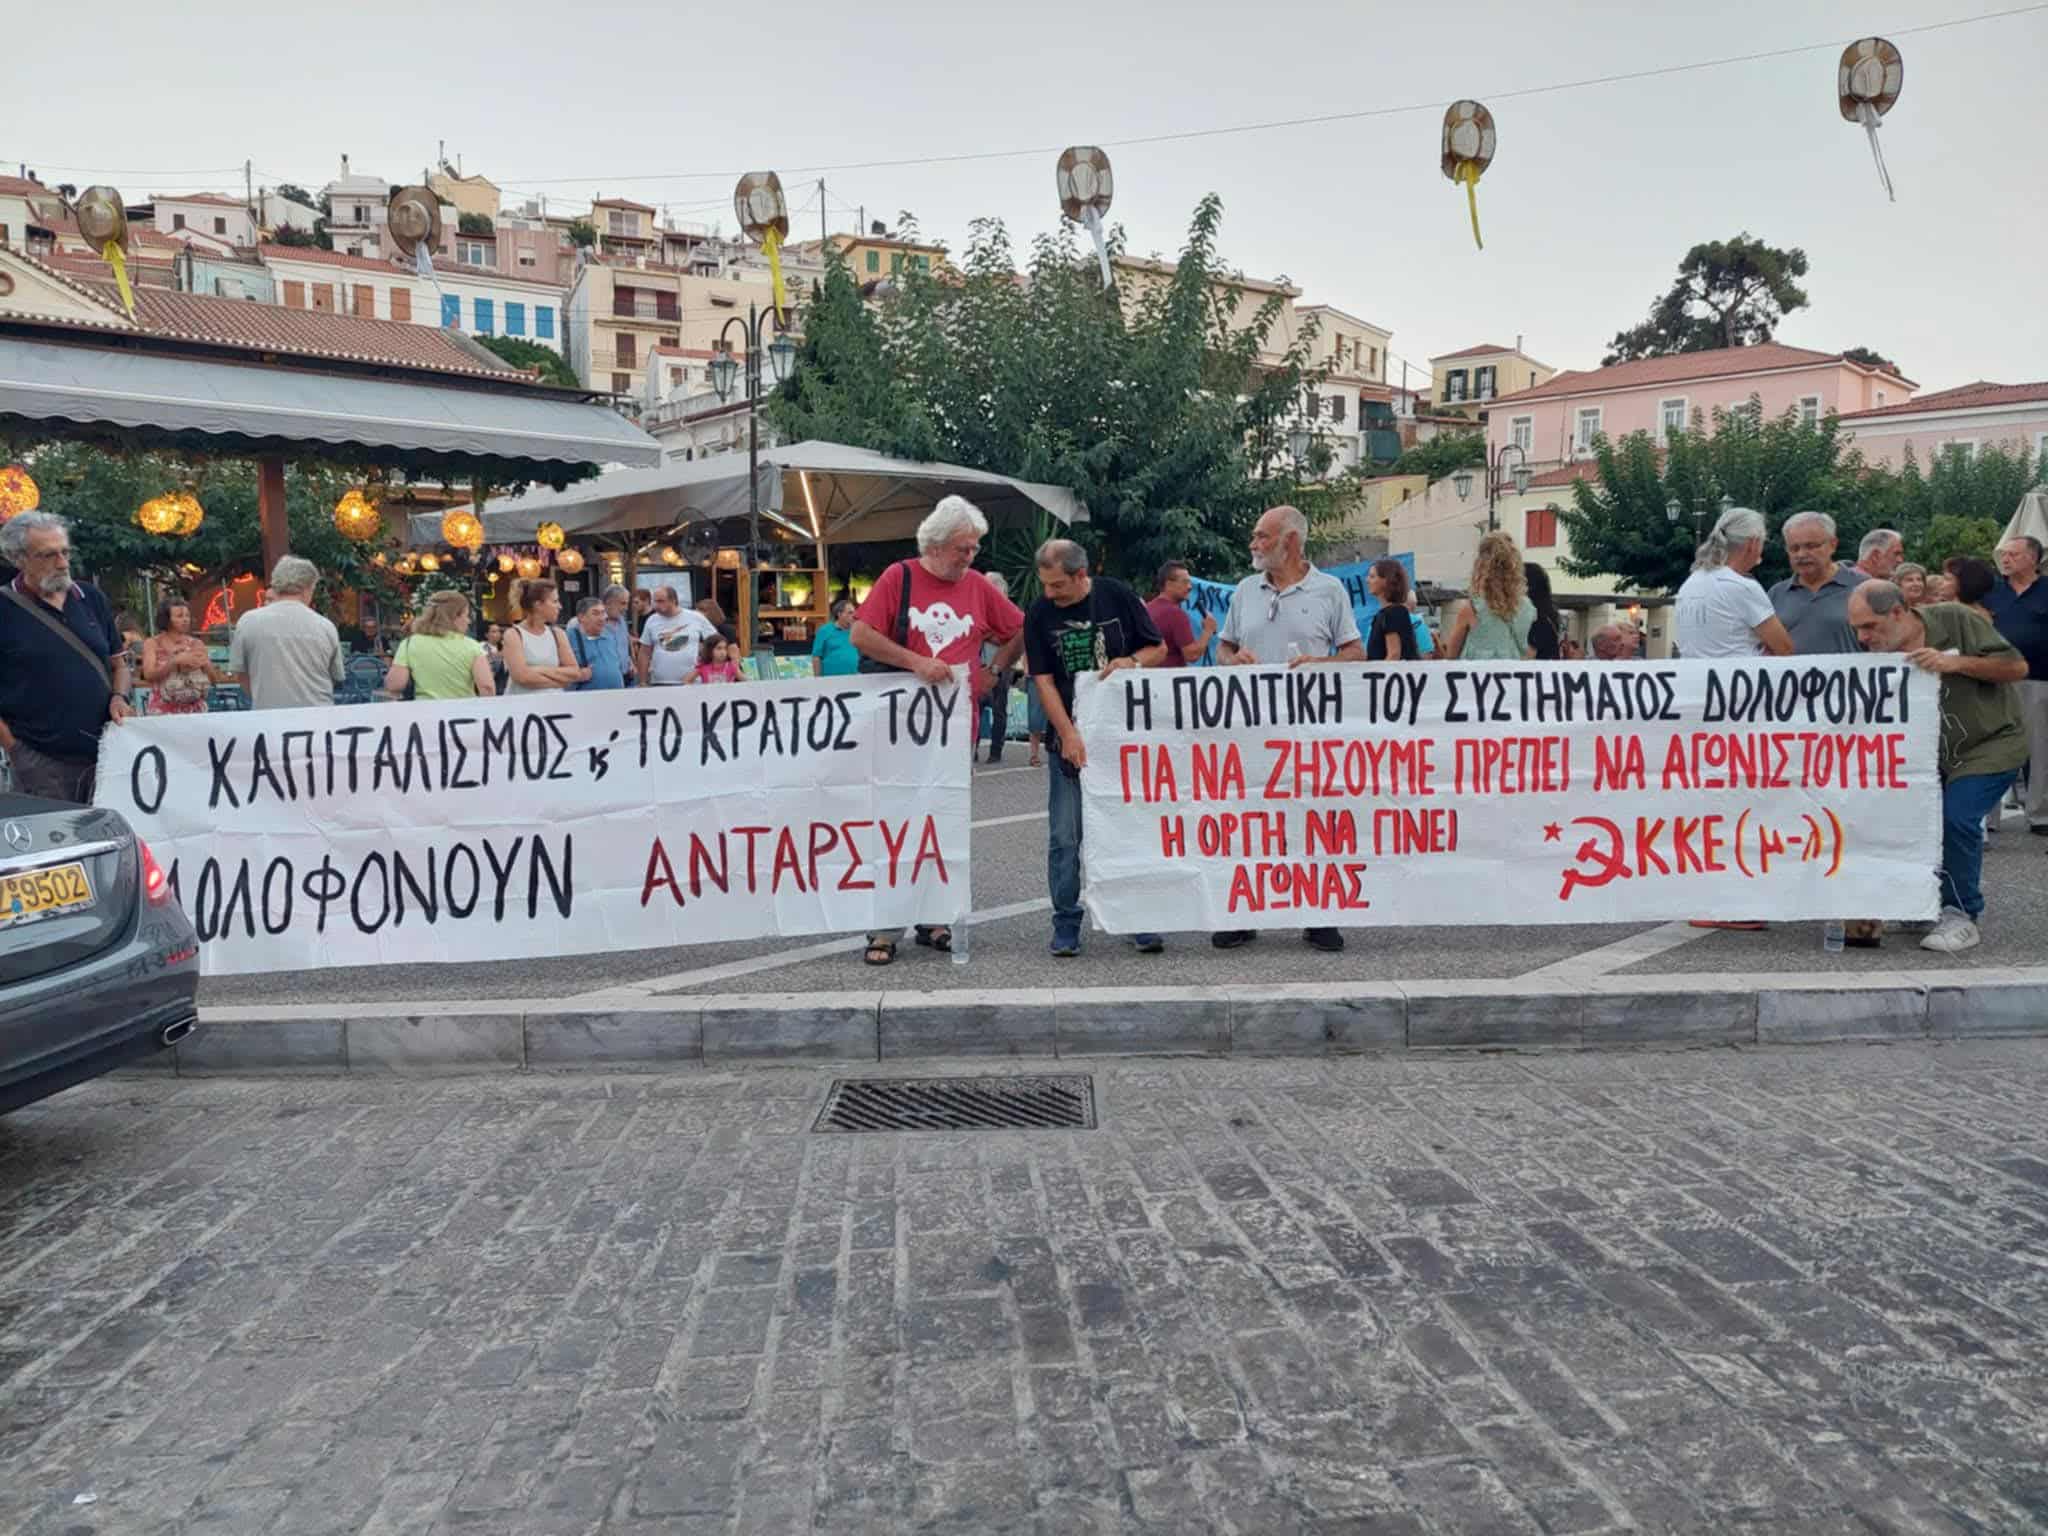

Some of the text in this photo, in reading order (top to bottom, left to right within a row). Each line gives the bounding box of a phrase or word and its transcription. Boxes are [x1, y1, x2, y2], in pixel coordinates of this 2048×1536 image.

[1126, 666, 1911, 732] Η ΠΟΛΙΤΙΚΗ ΤΟΥ ΣΥΣΤΗΜΑΤΟΣ ΔΟΛΟΦΟΝΕΙ
[131, 745, 168, 815] Ο
[207, 712, 574, 808] ΚΑΠΙΤΑΛΙΣΜΟΣ
[627, 706, 683, 768] ΤΟ
[700, 691, 863, 766] ΚΡΑΤΟΣ
[879, 685, 960, 747] ΤΟΥ
[1119, 732, 1908, 803] ΓΙΑ ΝΑ ΖΗΣΟΥΜΕ ΠΡΕΠΕΙ ΝΑ ΑΓΩΝΙΣΤΟΥΜΕ
[640, 815, 948, 907] ΑΝΤΑΡΣΥΑ
[1160, 808, 1458, 858] Η ΟΡΓΗ ΝΑ ΓΙΝΕΙ
[1228, 862, 1370, 913] ΑΓΩΝΑΣ
